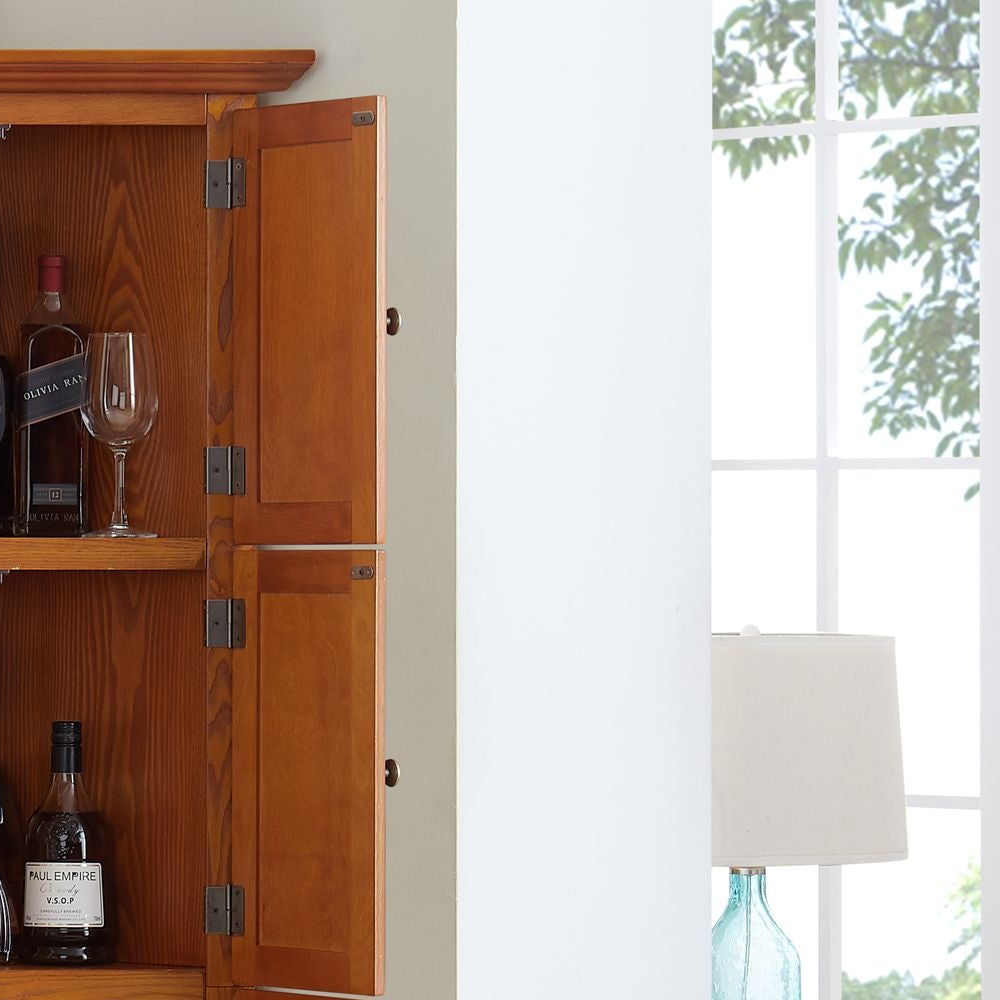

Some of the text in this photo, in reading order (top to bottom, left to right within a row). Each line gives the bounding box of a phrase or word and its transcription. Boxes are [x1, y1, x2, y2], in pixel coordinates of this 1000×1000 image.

[23, 383, 59, 401] OLIVIA
[52, 491, 60, 499] 12
[28, 871, 97, 881] PAUL EMPIRE
[46, 897, 75, 905] V.S.O.P
